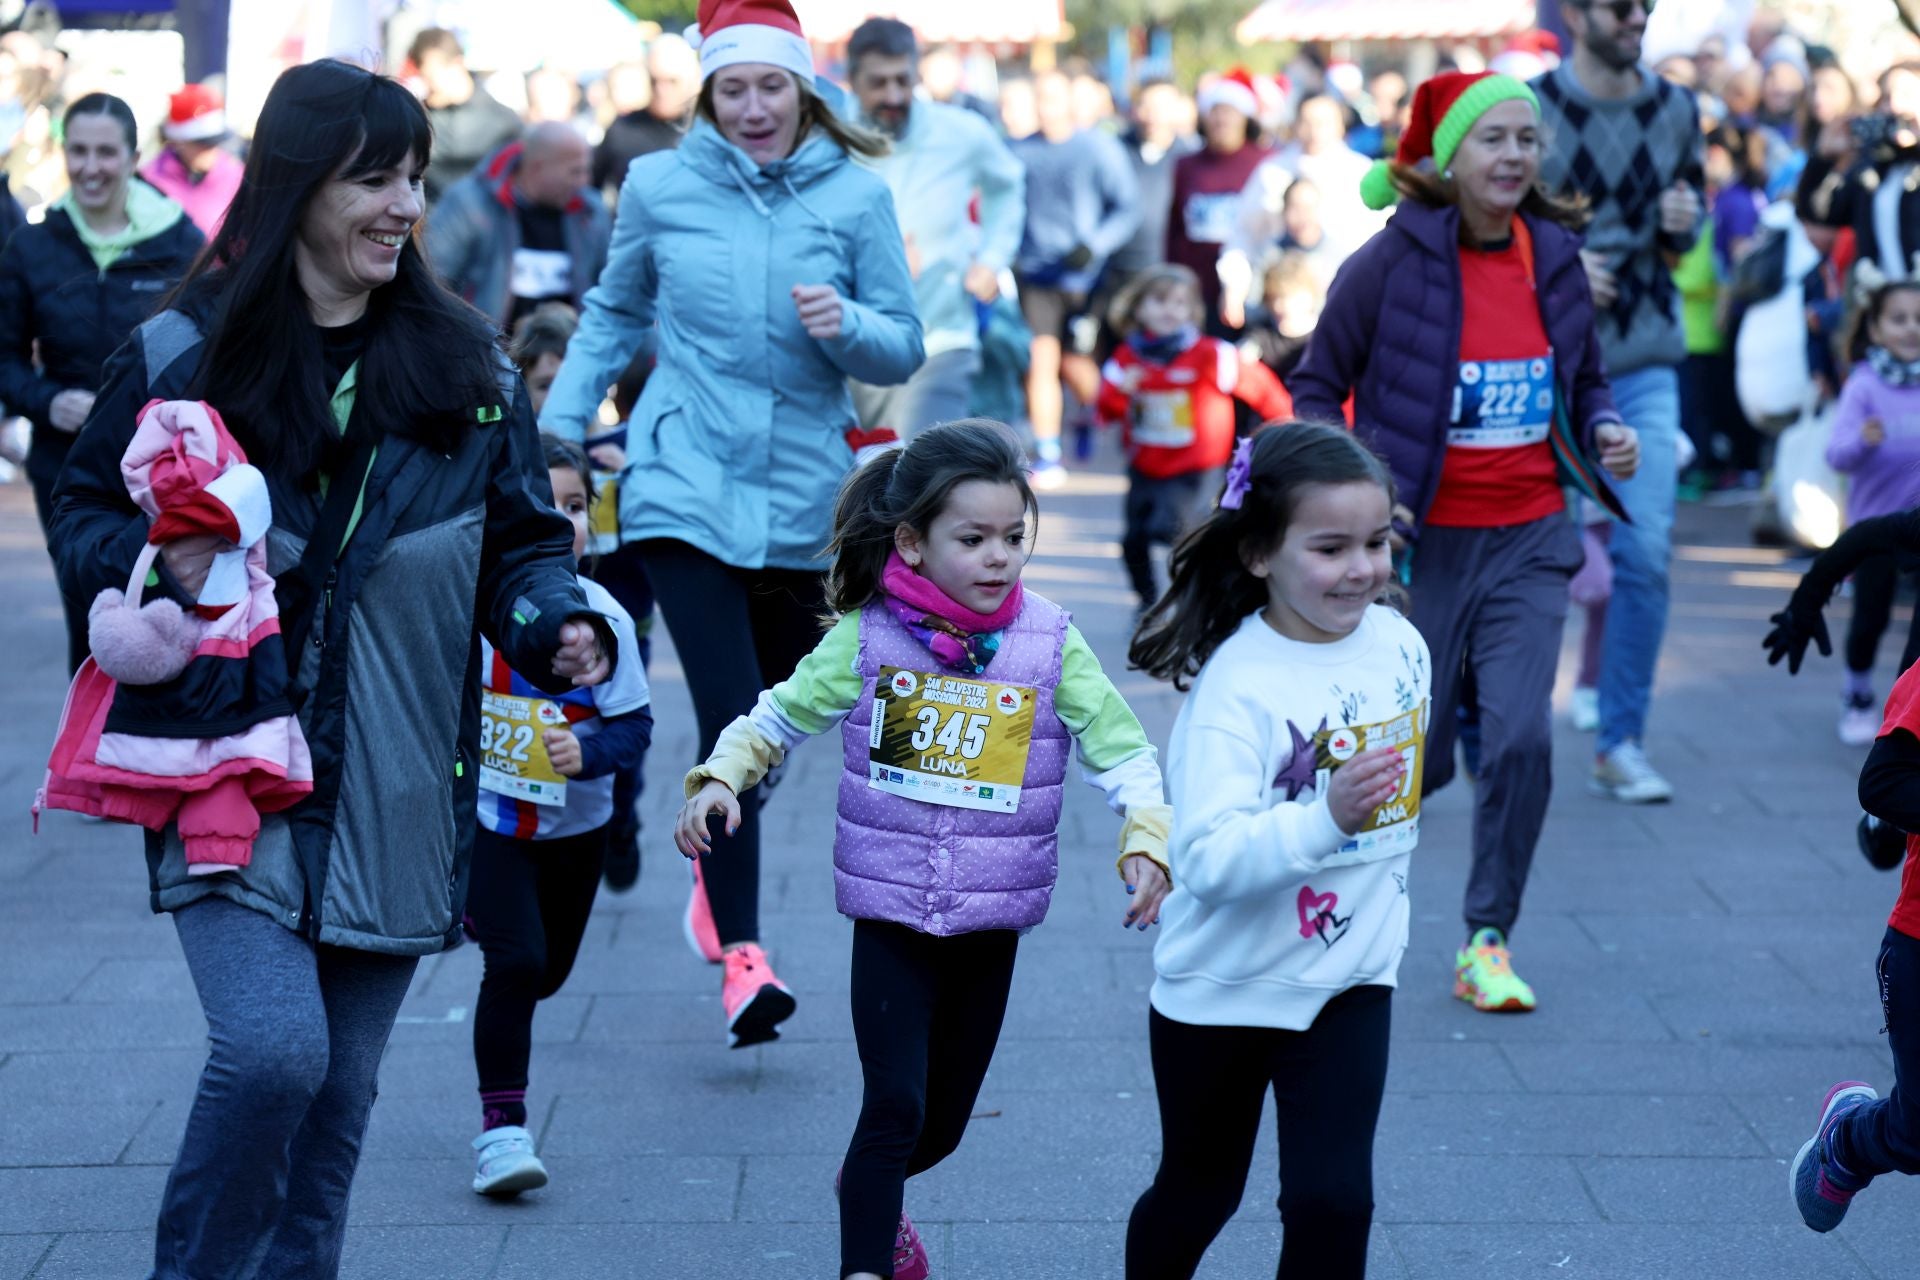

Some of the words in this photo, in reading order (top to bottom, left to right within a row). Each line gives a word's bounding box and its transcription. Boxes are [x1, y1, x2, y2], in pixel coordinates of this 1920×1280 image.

[1477, 380, 1531, 418] 222
[924, 676, 942, 691] SAN
[943, 679, 988, 698] SILVESTRE
[965, 694, 988, 709] 2024
[480, 715, 535, 763] 322
[911, 705, 992, 760] 345
[920, 755, 968, 777] LUNA
[1375, 803, 1408, 827] ANA
